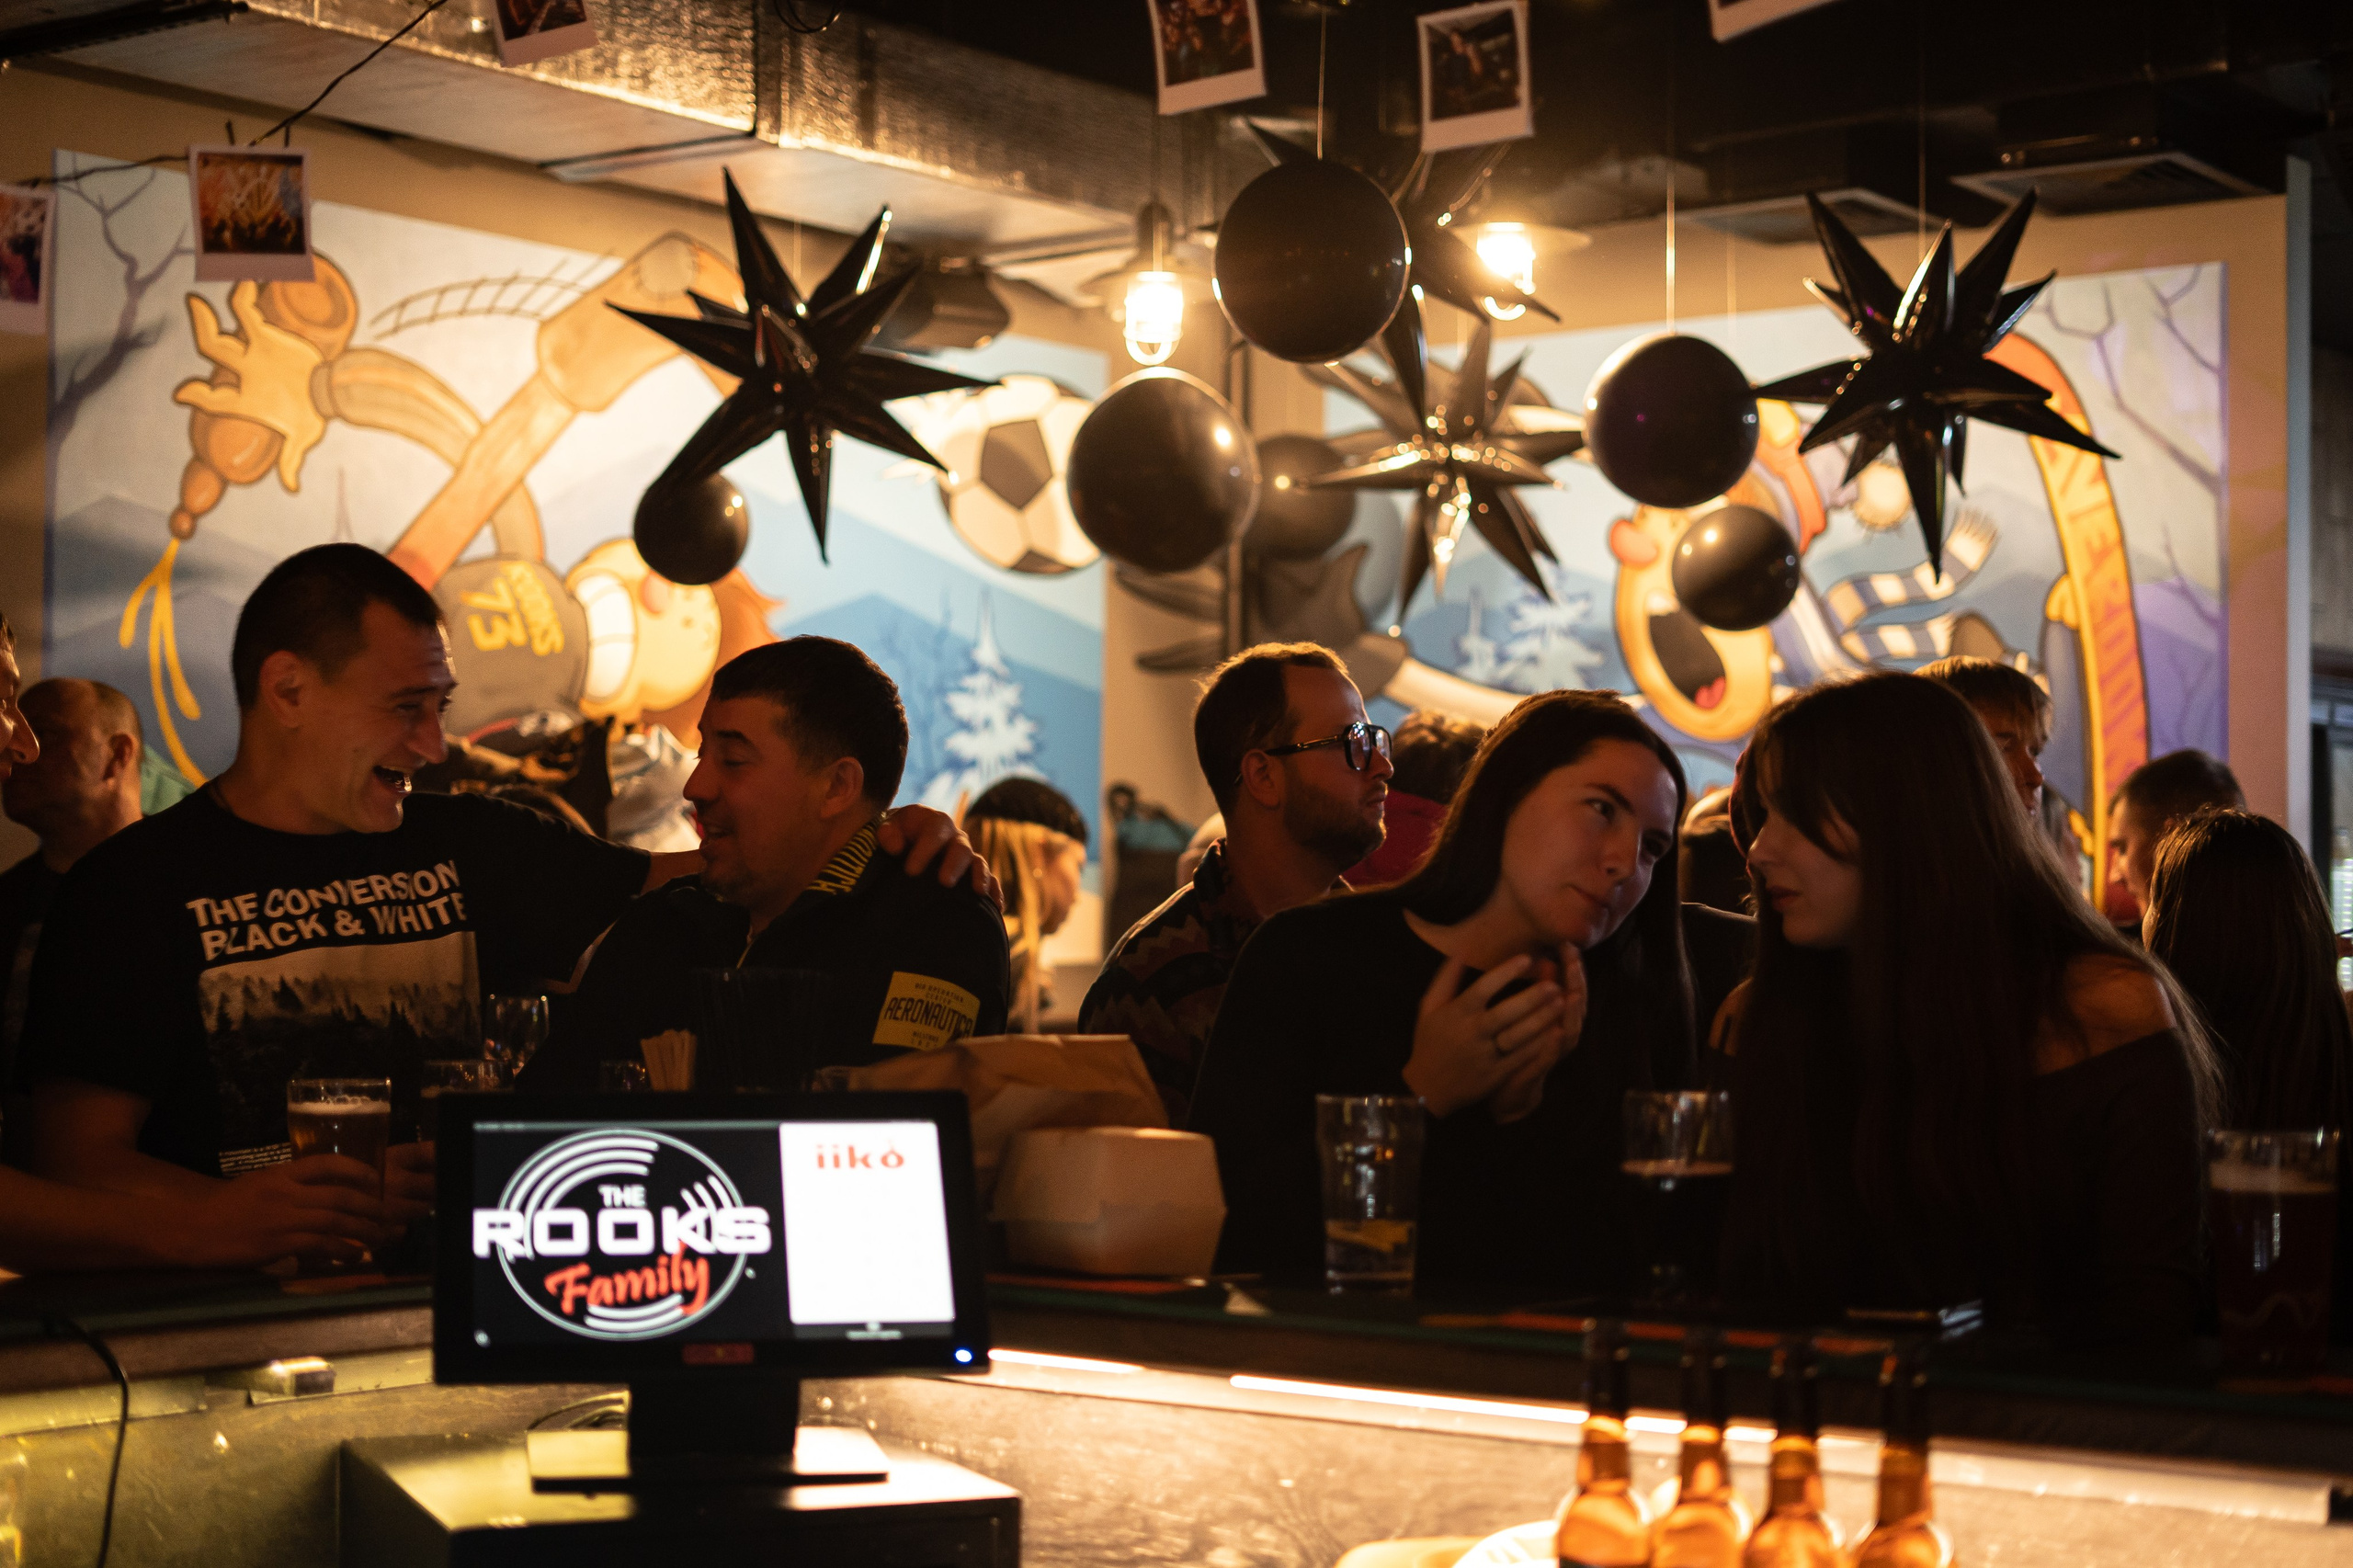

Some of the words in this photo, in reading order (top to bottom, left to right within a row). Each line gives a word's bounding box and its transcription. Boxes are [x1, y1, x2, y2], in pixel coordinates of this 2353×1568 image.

[460, 577, 530, 652] 73
[186, 892, 259, 927] THE
[199, 913, 329, 961] BLACK
[334, 909, 366, 937] &
[368, 892, 467, 936] WHITE
[814, 1140, 905, 1169] iiko
[597, 1184, 647, 1208] THE
[472, 1205, 773, 1259] ROOKS
[543, 1241, 710, 1315] Family
